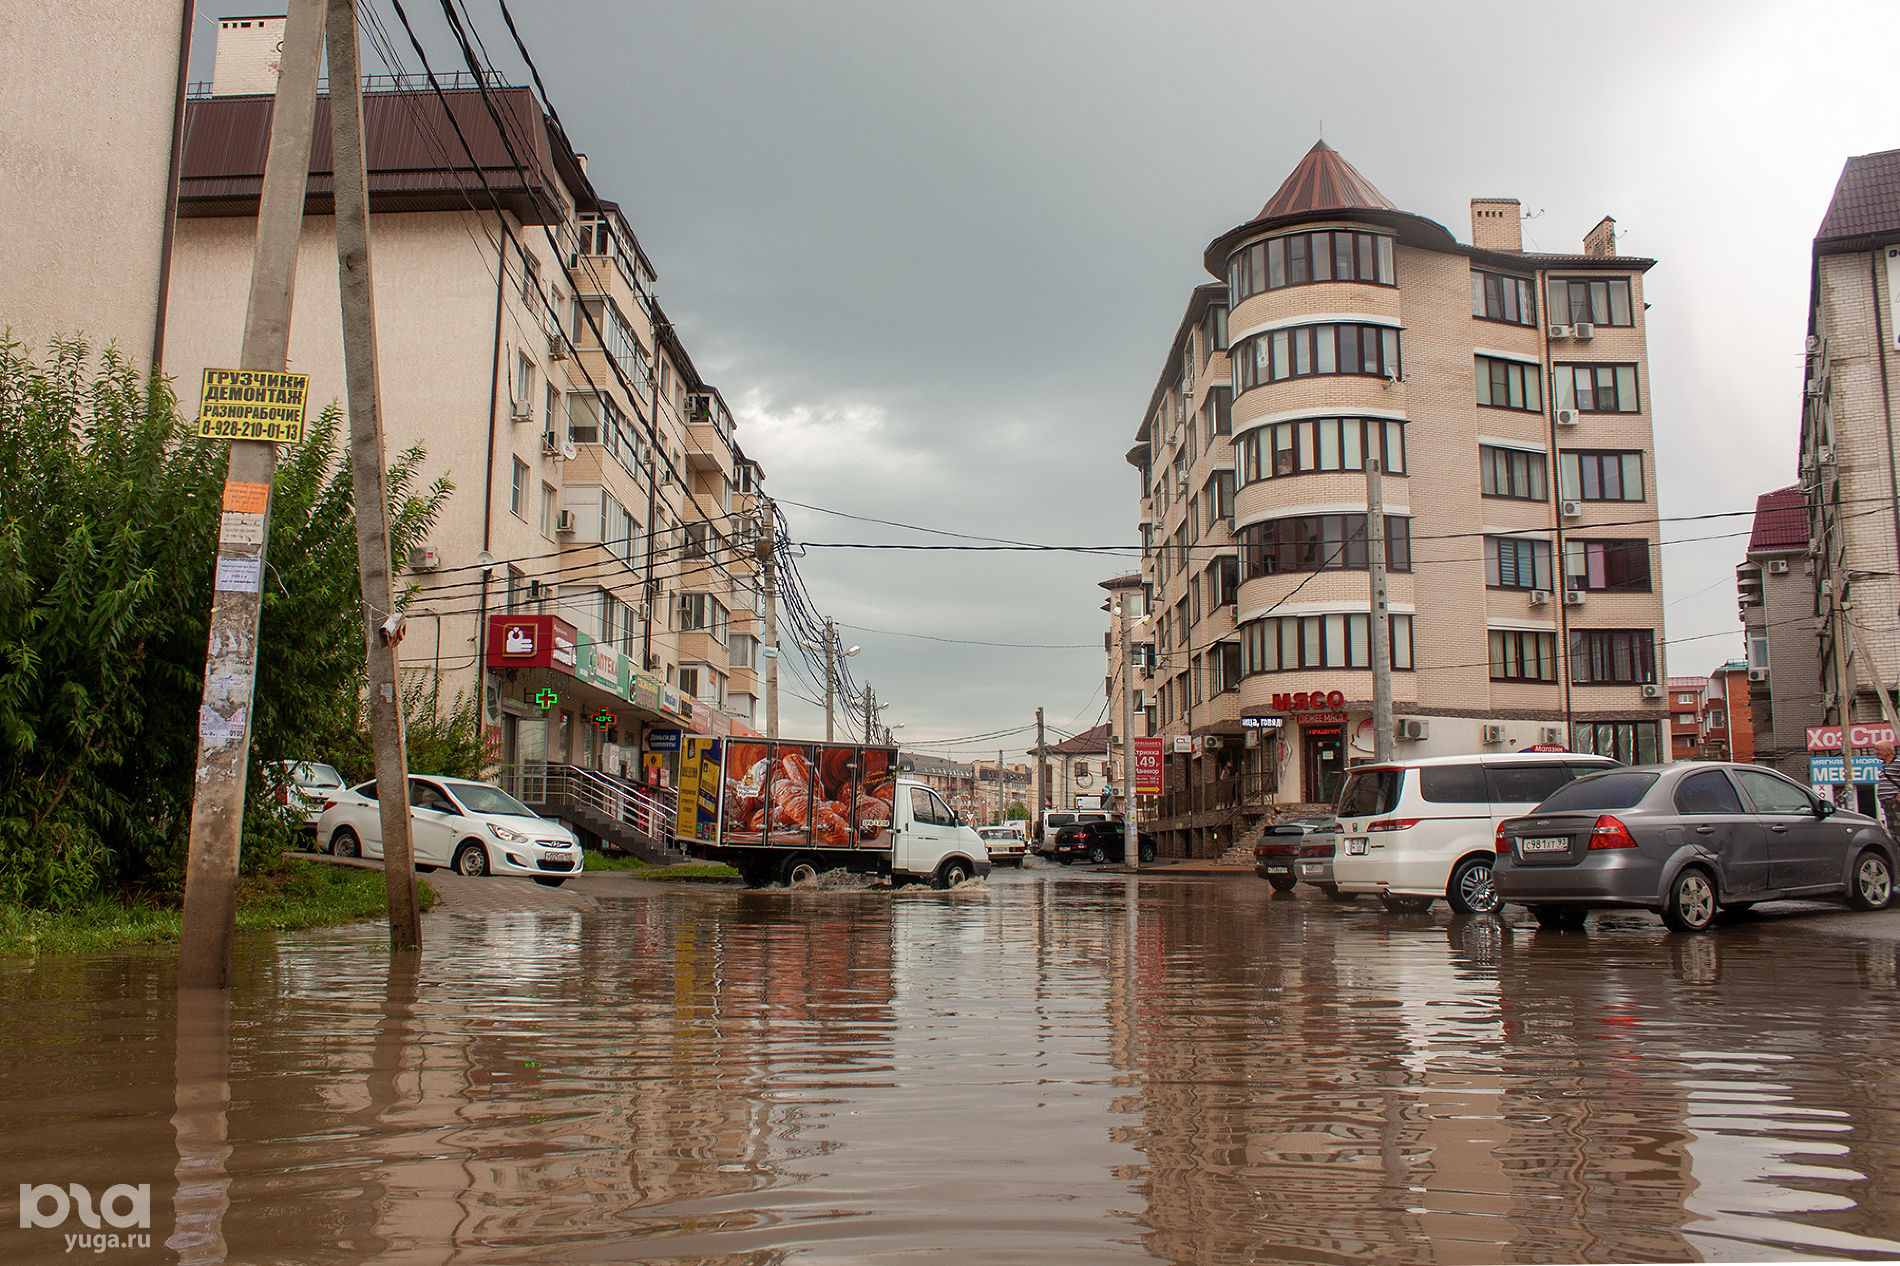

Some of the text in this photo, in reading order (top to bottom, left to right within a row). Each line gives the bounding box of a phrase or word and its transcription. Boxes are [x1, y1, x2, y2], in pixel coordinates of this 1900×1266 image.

[207, 371, 305, 388] ГРУЗЧИКИ
[204, 386, 302, 405] ДЕМОНТАЖ
[203, 405, 300, 422] РАЗНОРАБОЧИЕ
[202, 420, 298, 440] 8-928-210-01-13
[1272, 690, 1344, 711] МЯСО
[1535, 745, 1563, 753] Магазин
